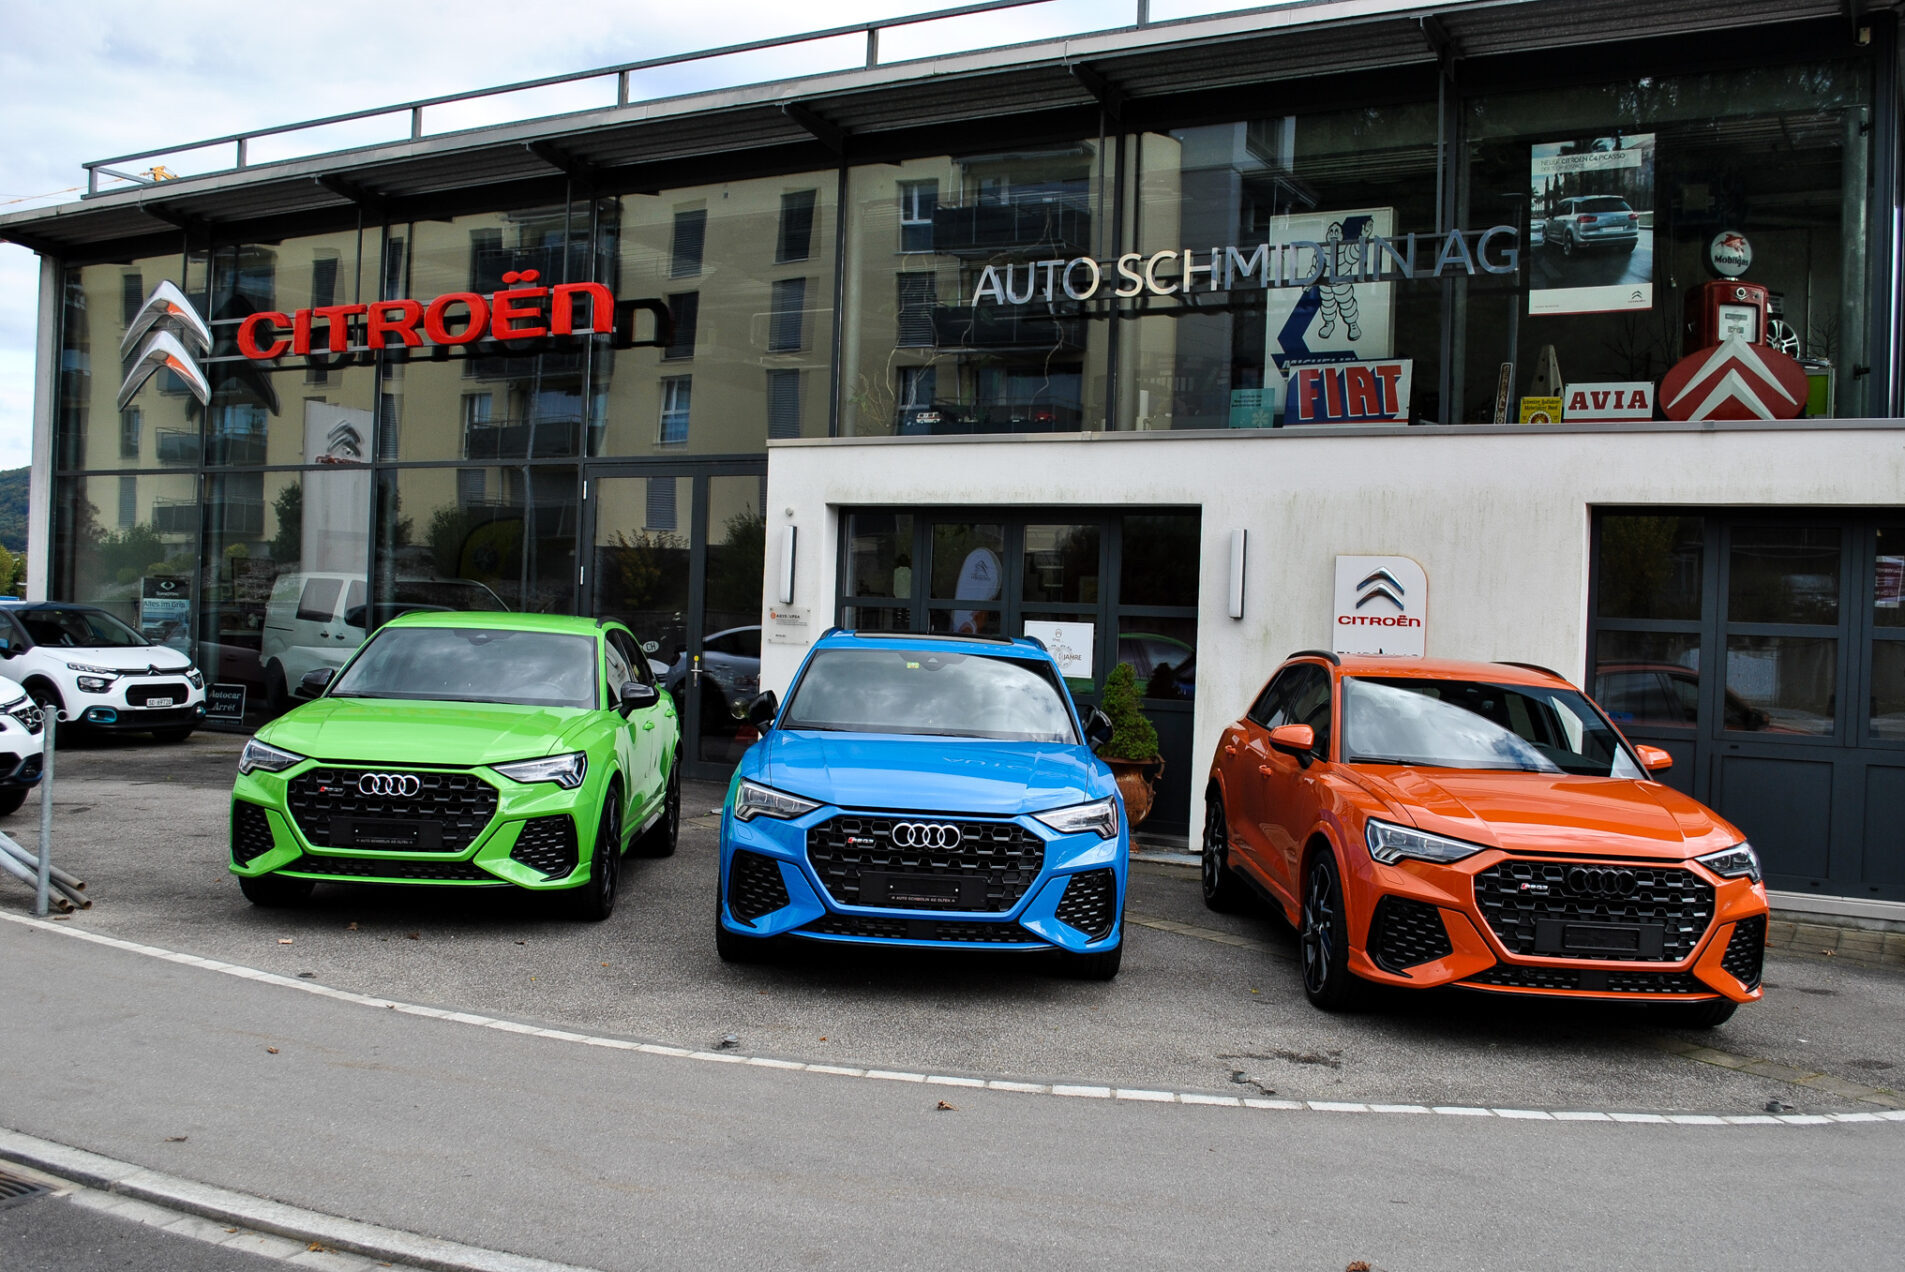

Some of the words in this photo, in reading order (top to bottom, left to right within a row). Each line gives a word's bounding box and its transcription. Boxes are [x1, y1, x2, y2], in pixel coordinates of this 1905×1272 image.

[1597, 152, 1626, 162] PICASSO
[971, 256, 1100, 307] AUTO
[1115, 232, 1415, 298] SCHMIDLIN
[1433, 225, 1519, 277] AG
[1714, 255, 1749, 268] Mobilgas
[237, 268, 615, 360] CITROËN
[1297, 364, 1403, 420] FIAT
[1568, 390, 1649, 411] AVIA
[1338, 614, 1421, 628] CITROËN
[645, 643, 657, 651] CH
[209, 690, 242, 700] Autocar
